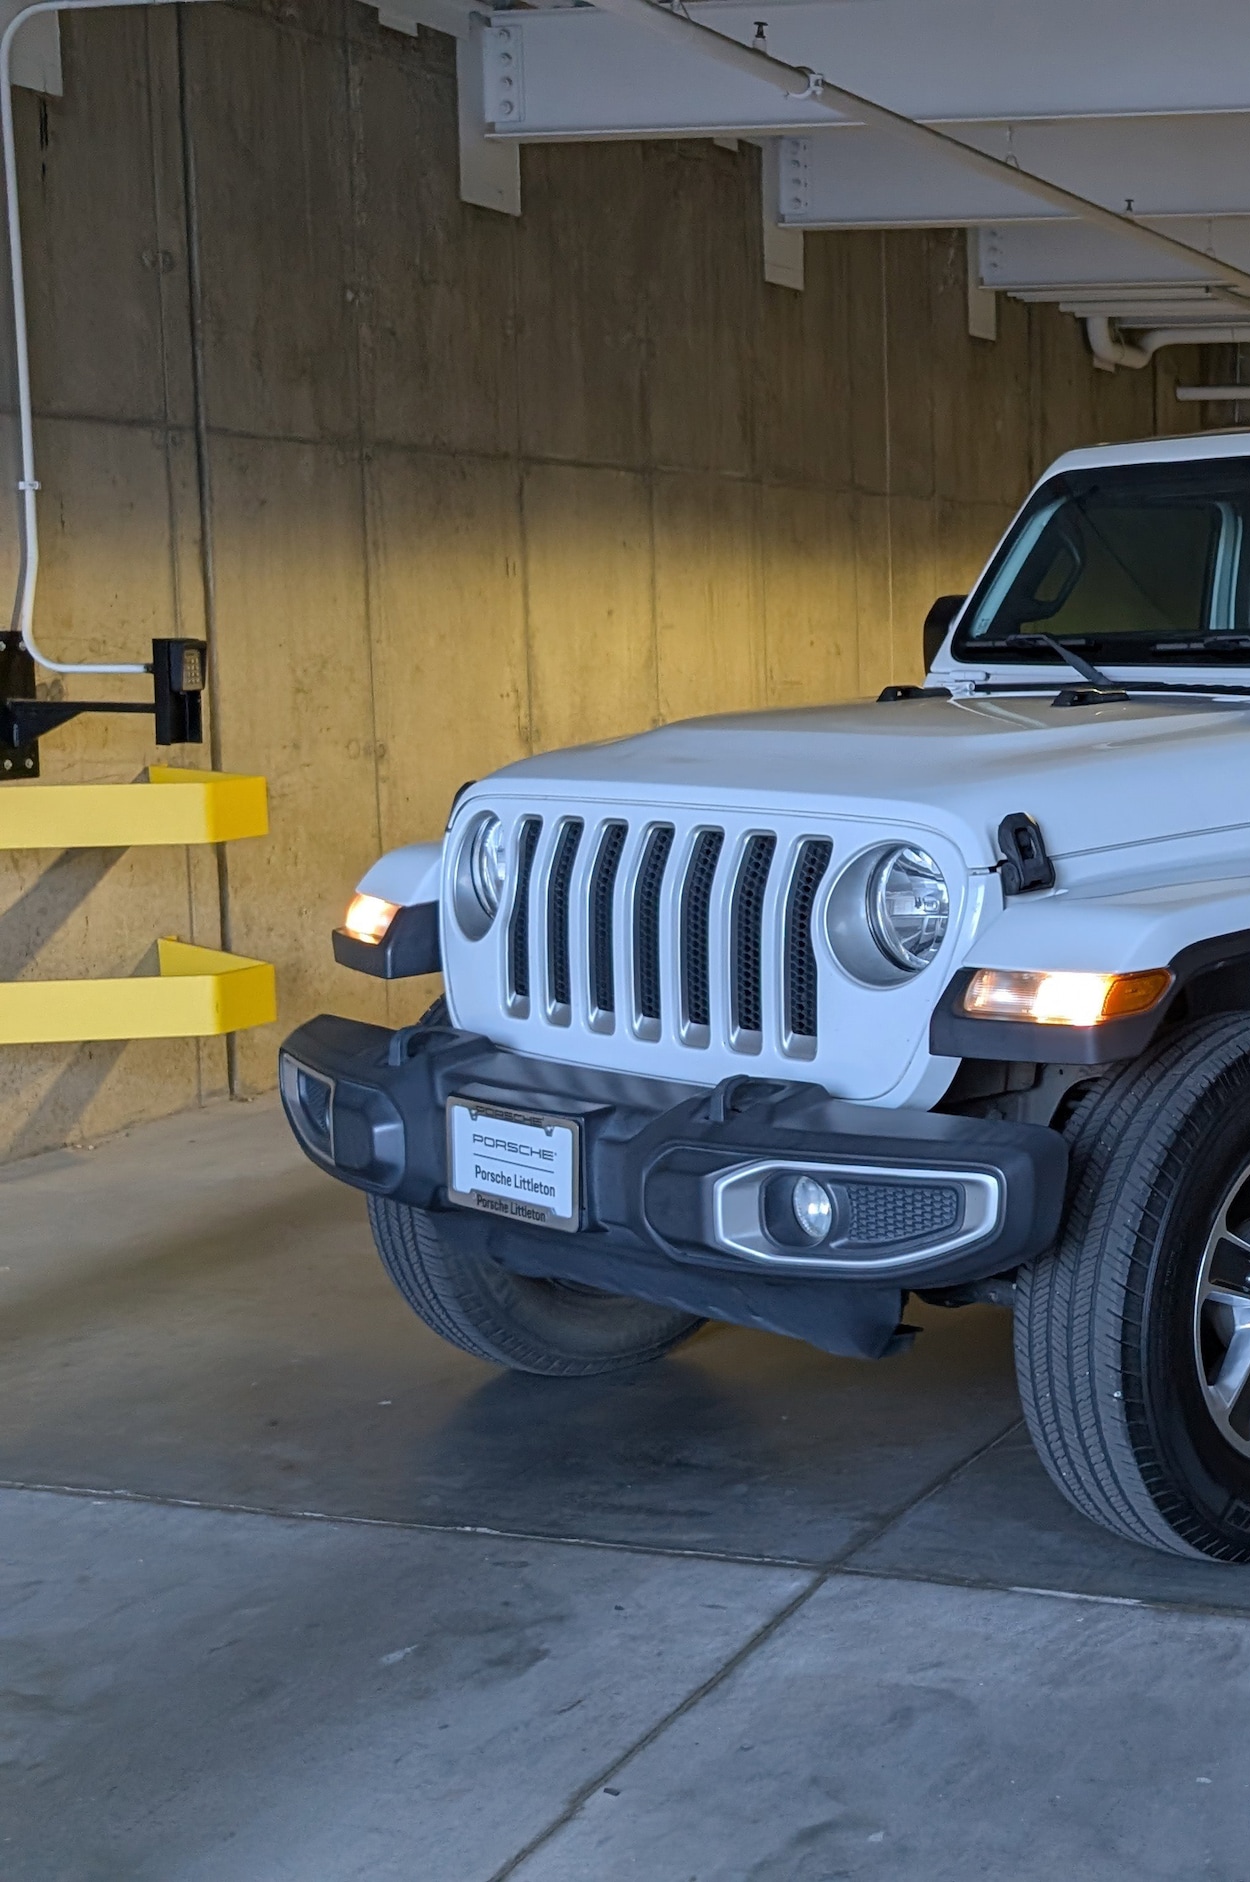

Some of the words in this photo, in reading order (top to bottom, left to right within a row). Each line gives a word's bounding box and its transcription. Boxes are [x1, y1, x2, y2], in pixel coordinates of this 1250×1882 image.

[472, 1133, 554, 1162] PORSCHE
[475, 1164, 512, 1187] Porsche
[514, 1175, 556, 1198] Littleton
[475, 1193, 509, 1214] Porsche
[510, 1204, 546, 1222] Littleton
